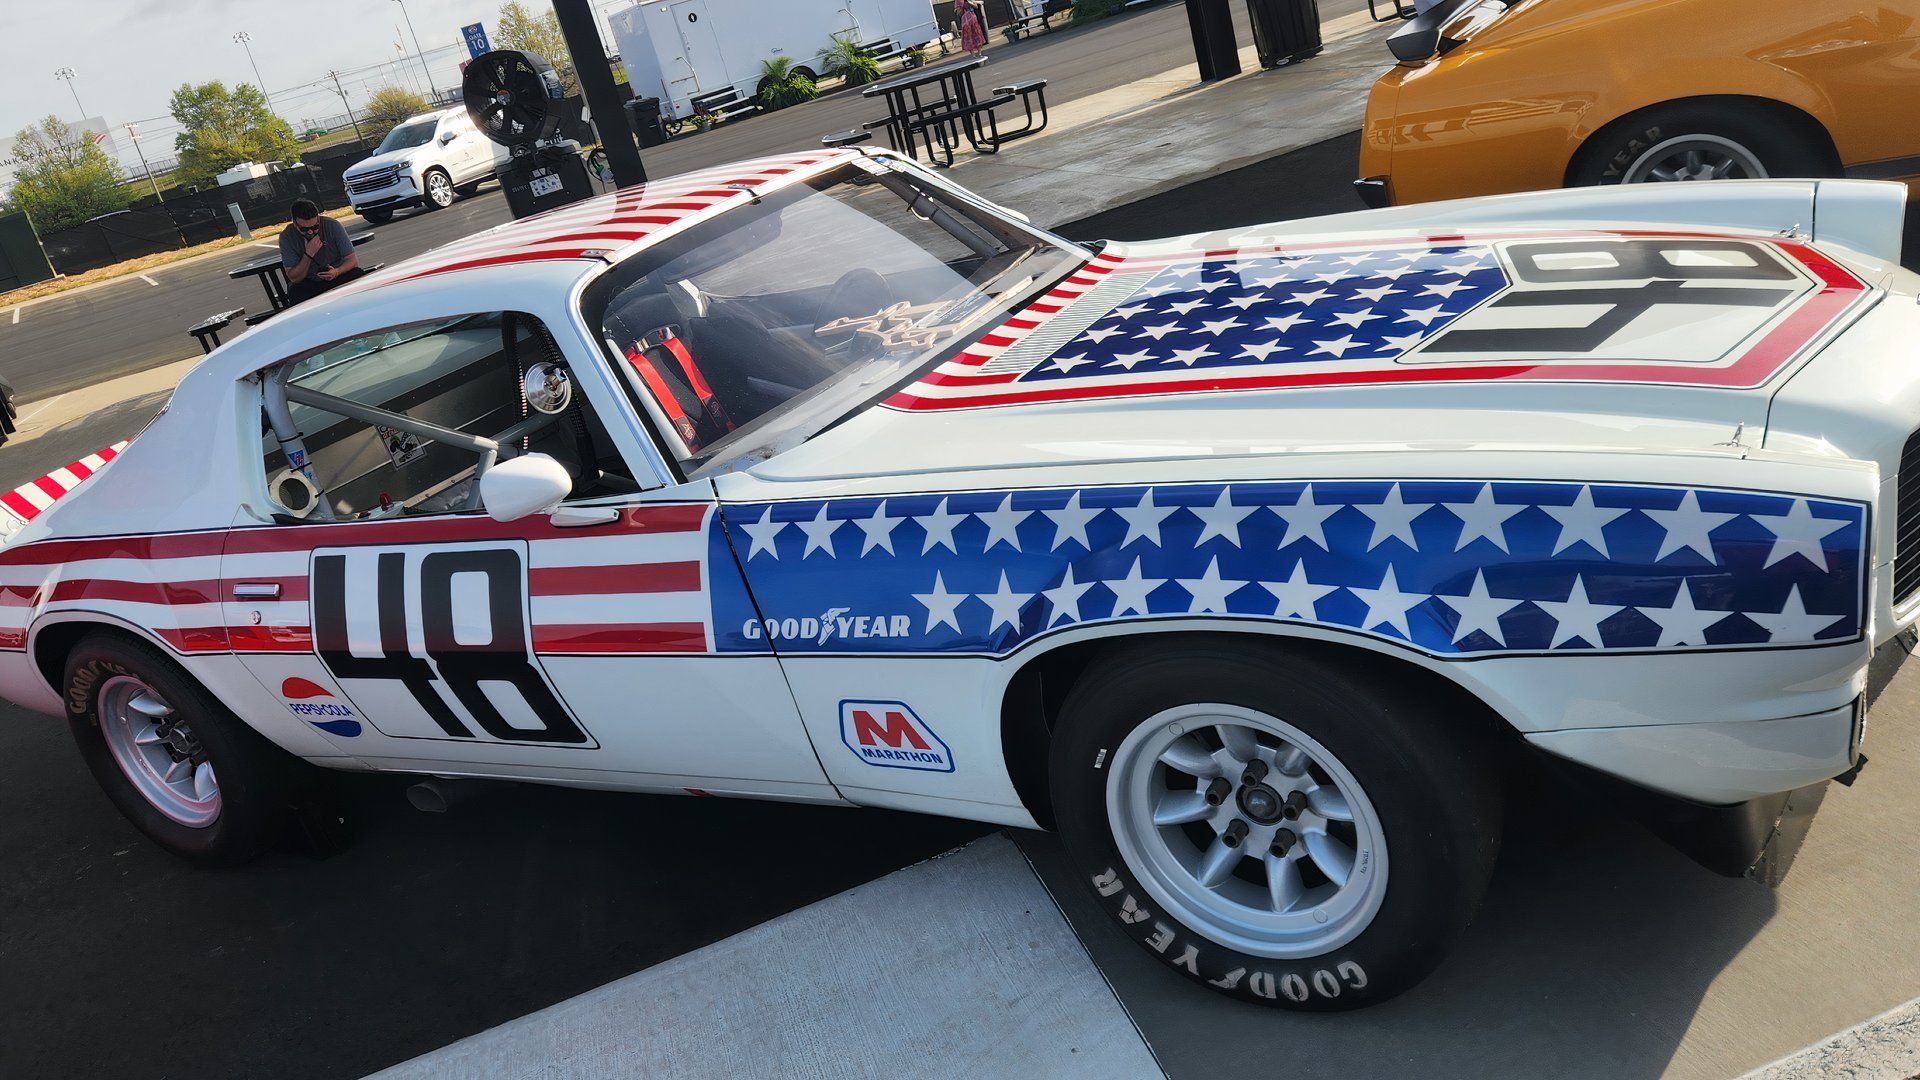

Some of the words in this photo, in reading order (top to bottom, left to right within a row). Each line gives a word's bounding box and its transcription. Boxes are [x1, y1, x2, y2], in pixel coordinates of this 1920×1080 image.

[469, 33, 482, 41] GATE
[471, 39, 485, 51] 10
[314, 548, 588, 744] 48
[852, 710, 932, 751] M
[861, 748, 943, 764] MARATHON
